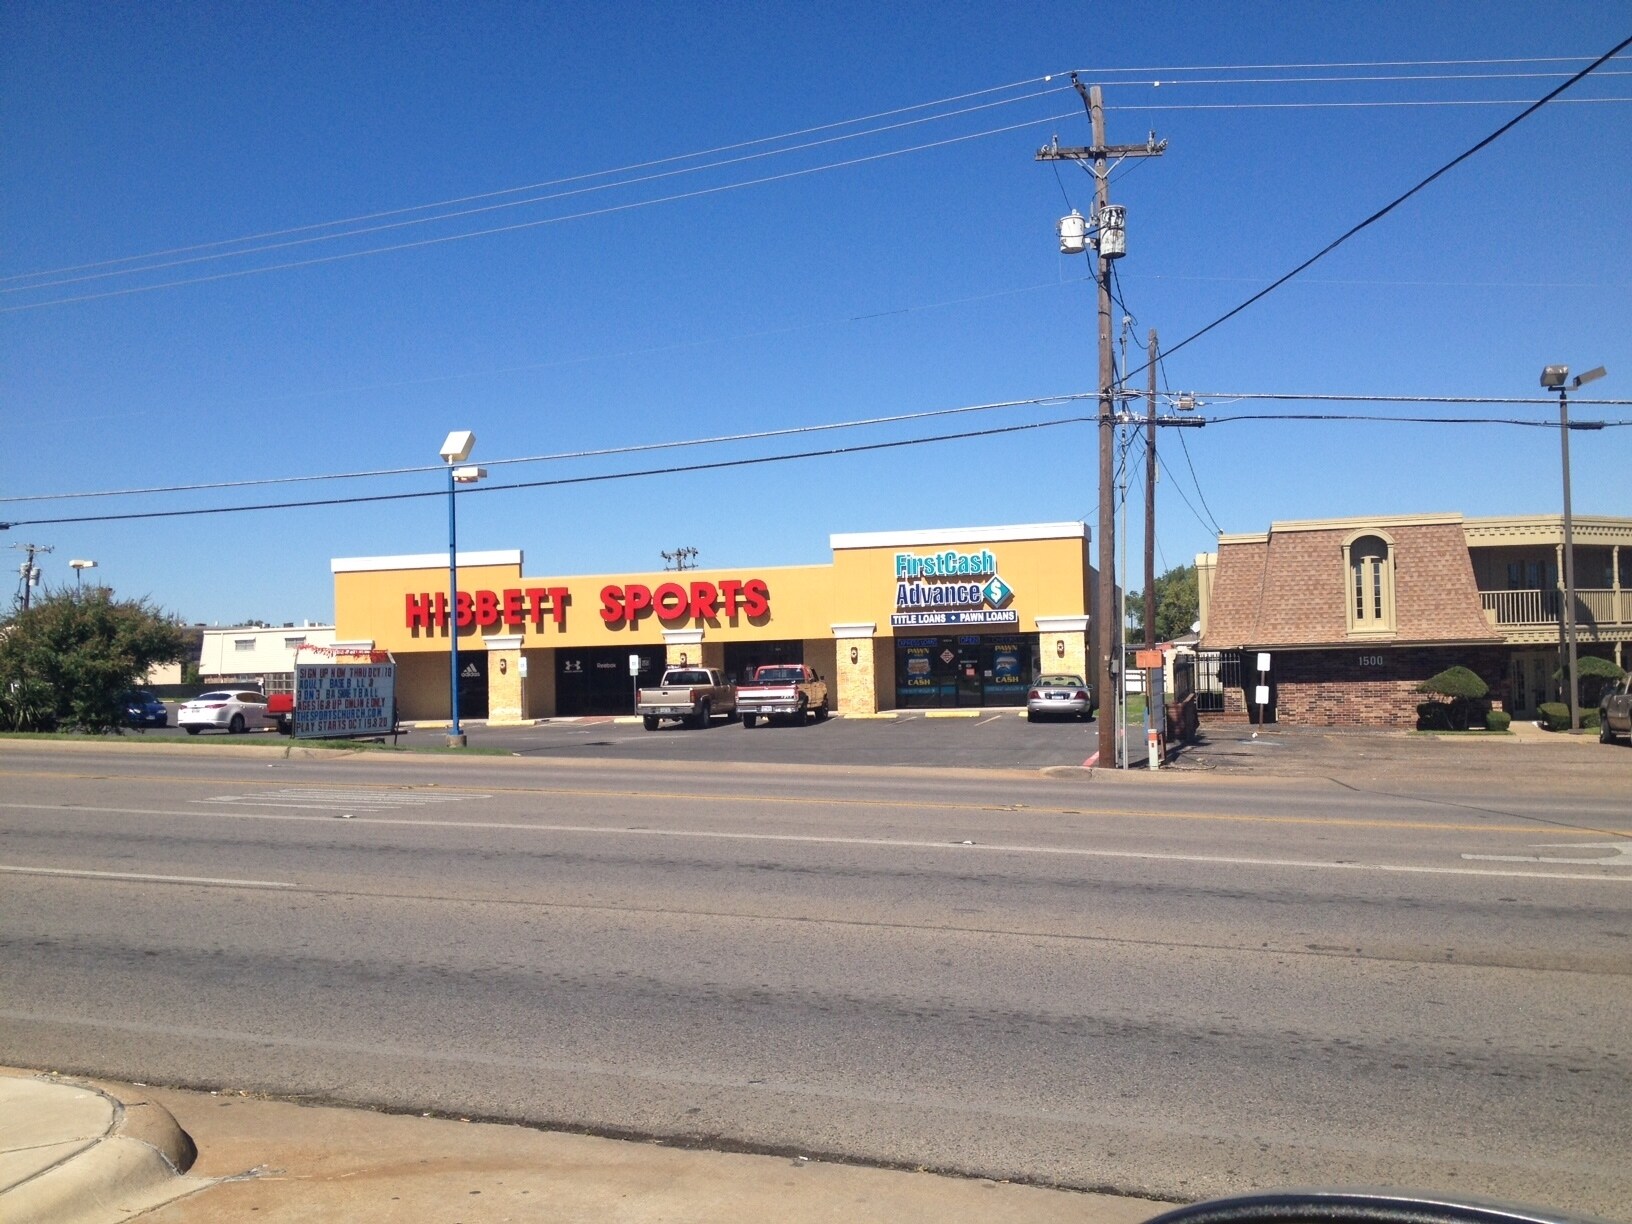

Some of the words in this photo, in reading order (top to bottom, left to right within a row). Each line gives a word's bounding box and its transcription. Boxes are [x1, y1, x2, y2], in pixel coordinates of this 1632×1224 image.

[896, 551, 994, 576] FirstCash
[896, 582, 981, 604] Advance
[406, 586, 568, 628] HIBBETT
[600, 579, 770, 622] SPORTS
[893, 614, 916, 624] TITLE
[918, 614, 946, 624] LOANS
[960, 612, 986, 622] PAWN
[986, 610, 1015, 621] LOANS
[1358, 656, 1383, 666] 1500
[300, 668, 316, 678] SIGN
[320, 668, 328, 678] UP
[299, 679, 323, 689] ADULT
[297, 691, 302, 700] 3
[304, 690, 314, 700] ON
[316, 690, 320, 700] 3
[297, 700, 316, 711] AGES
[332, 699, 342, 709] UP
[296, 722, 315, 732] PLAY
[318, 720, 346, 731] STARTS
[349, 719, 362, 729] OCT
